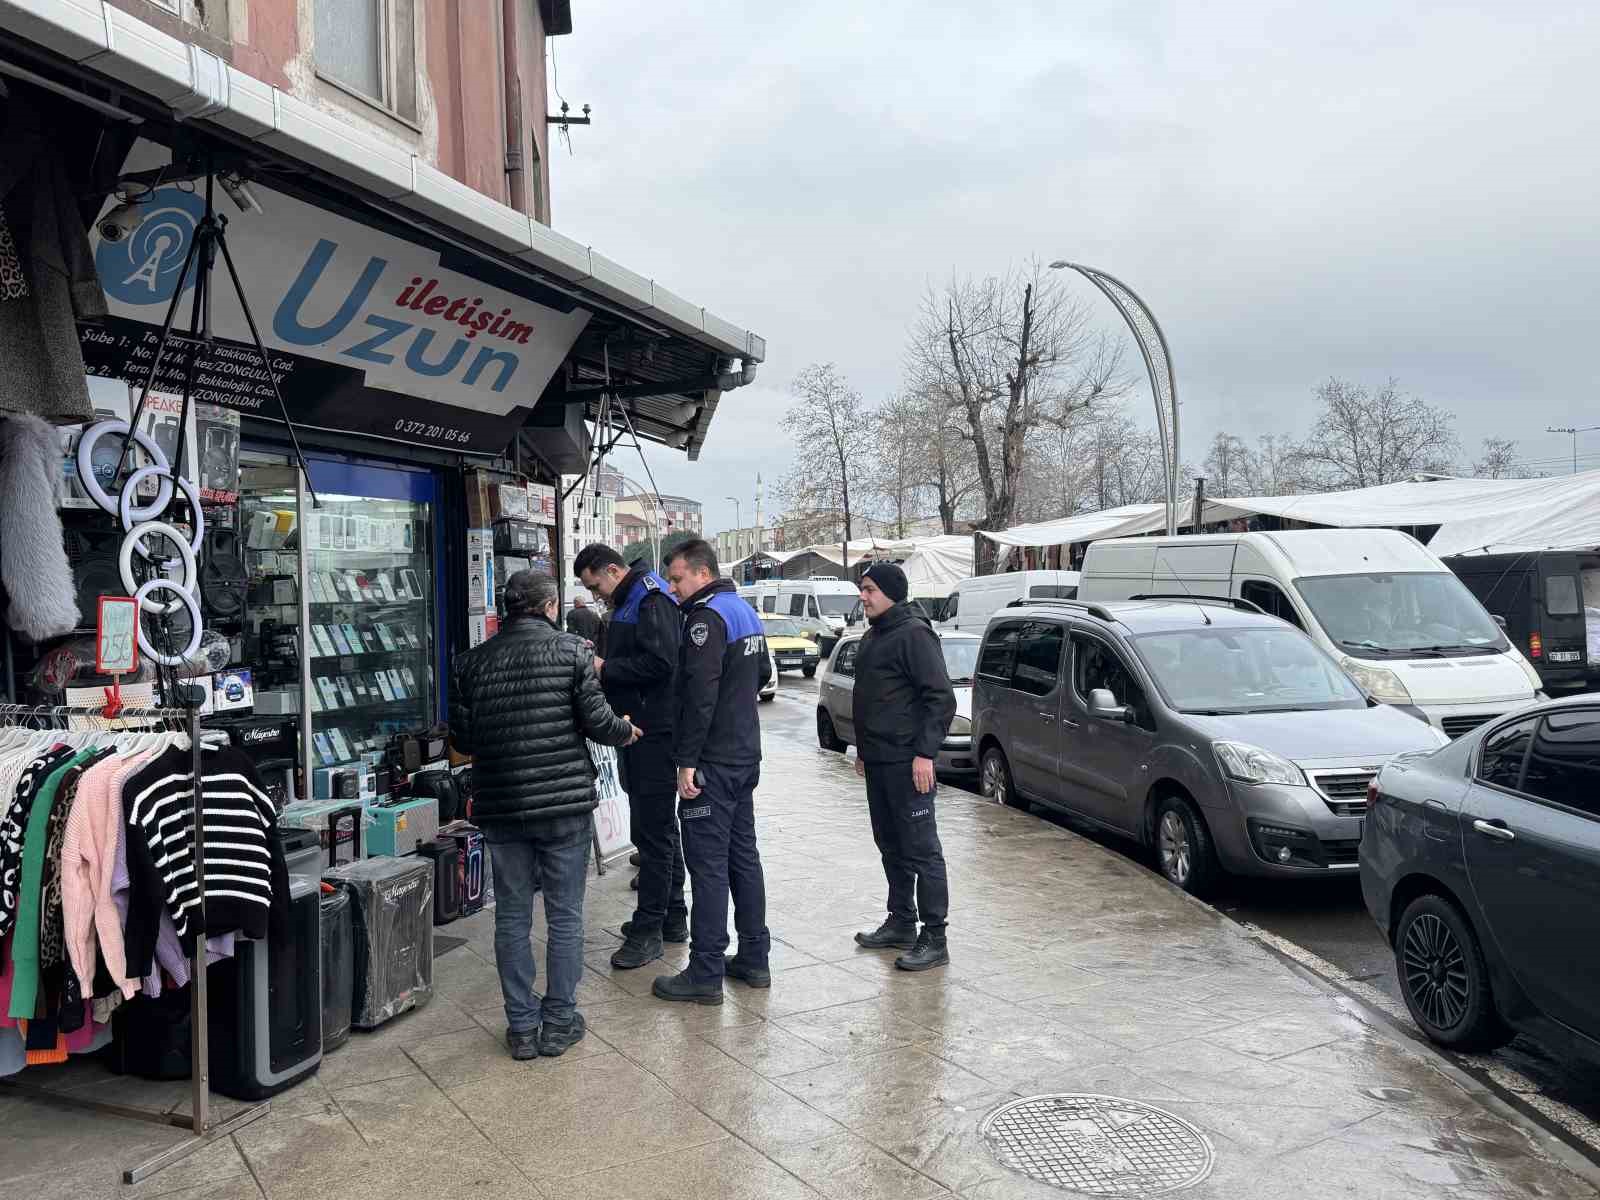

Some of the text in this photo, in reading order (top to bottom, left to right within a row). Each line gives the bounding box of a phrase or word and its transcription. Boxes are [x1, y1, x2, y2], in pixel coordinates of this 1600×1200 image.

[273, 238, 520, 393] Uzun
[395, 277, 534, 344] iletişim
[144, 394, 184, 414] PEAKE
[395, 419, 404, 431] 0
[404, 420, 425, 434] 372
[424, 425, 444, 438] 201
[445, 429, 459, 441] 05
